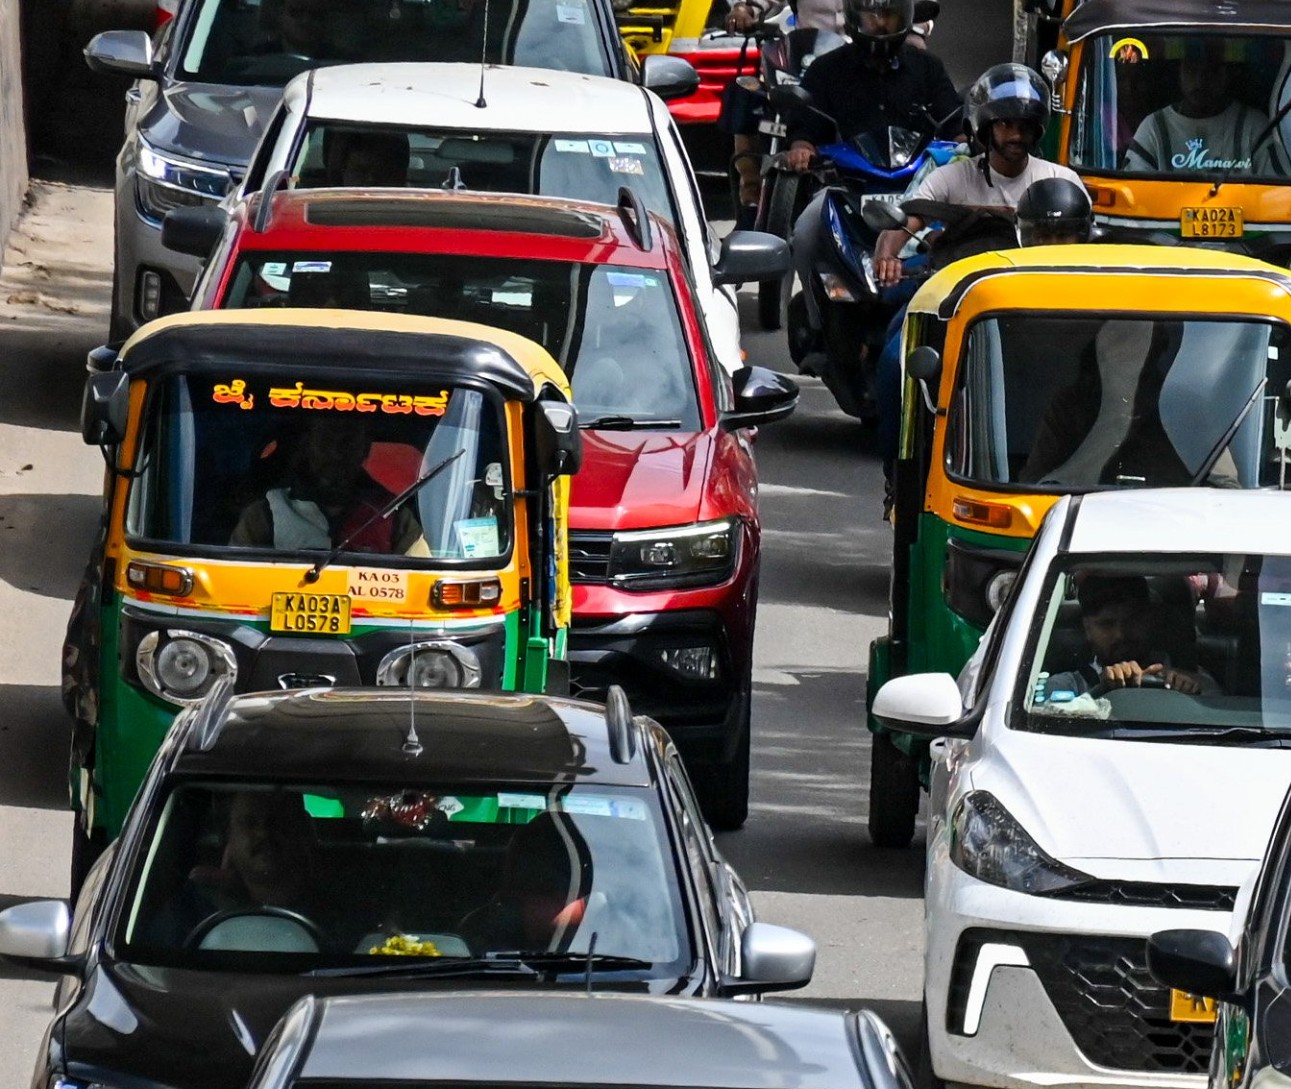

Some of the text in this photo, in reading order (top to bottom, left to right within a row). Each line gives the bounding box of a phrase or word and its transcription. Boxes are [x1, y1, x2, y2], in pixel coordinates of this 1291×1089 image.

[1193, 209, 1235, 222] KA02A
[1193, 223, 1236, 236] L8173
[212, 379, 449, 416] ಜೈ ಕರ್ನಾಟಕ
[358, 571, 400, 583] KA 03
[348, 586, 405, 599] AL 0578
[285, 595, 341, 614] KA03A
[284, 614, 341, 632] L0578
